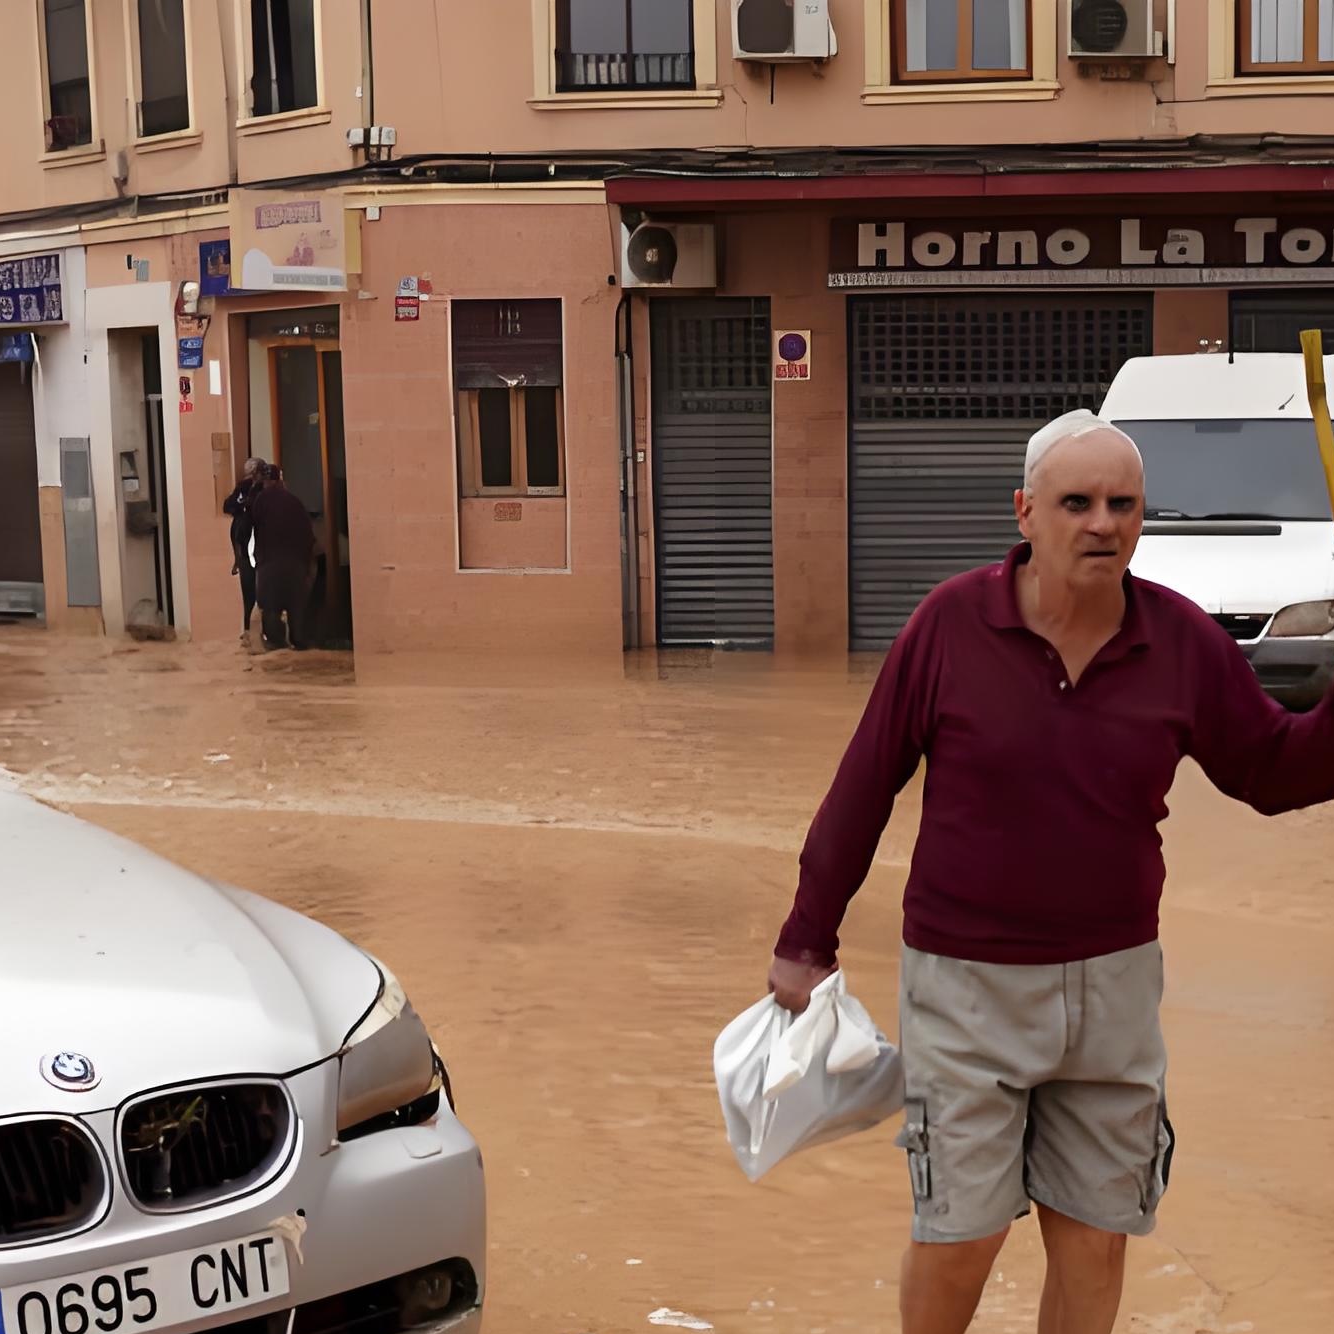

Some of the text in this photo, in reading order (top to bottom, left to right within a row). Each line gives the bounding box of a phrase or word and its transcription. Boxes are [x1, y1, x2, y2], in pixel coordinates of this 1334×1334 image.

[857, 222, 1091, 267] Horno
[1120, 218, 1205, 265] La
[190, 1236, 274, 1309] CNT
